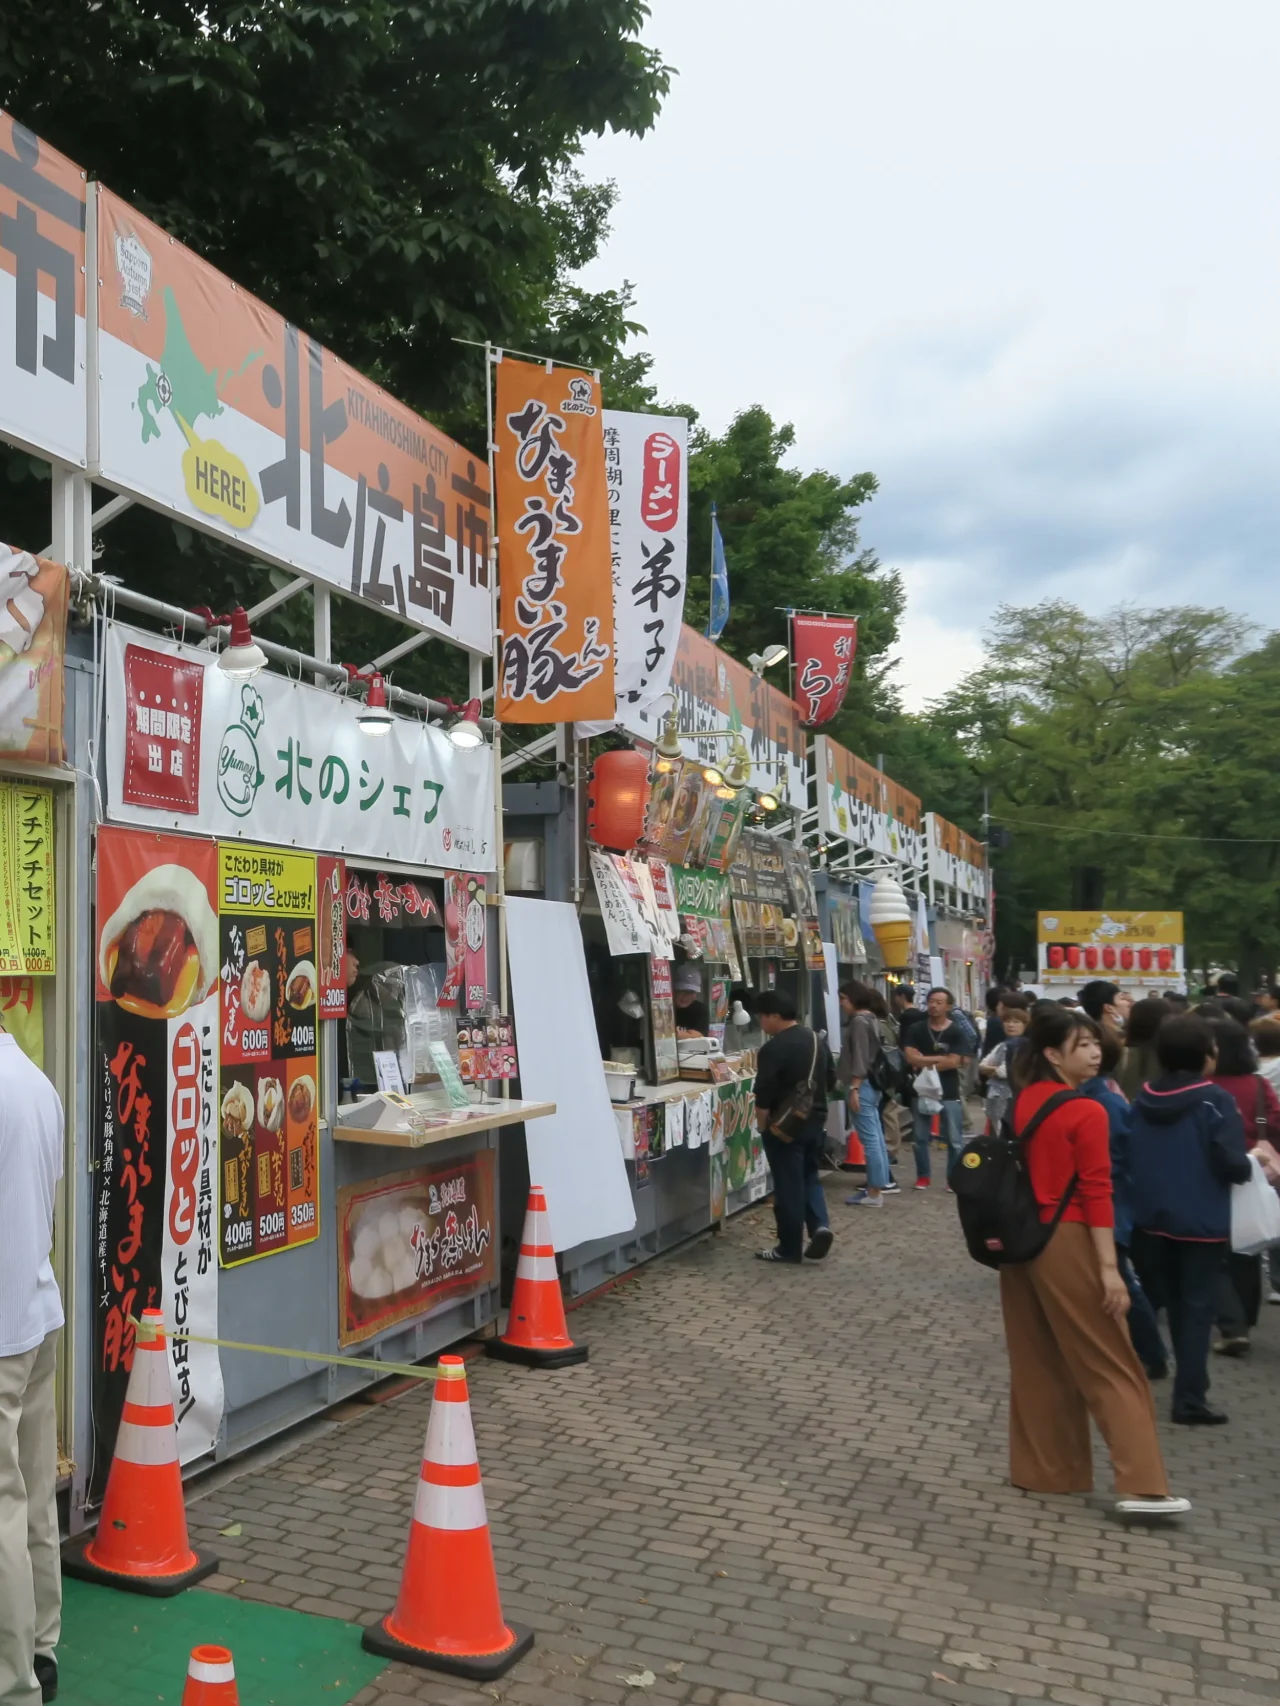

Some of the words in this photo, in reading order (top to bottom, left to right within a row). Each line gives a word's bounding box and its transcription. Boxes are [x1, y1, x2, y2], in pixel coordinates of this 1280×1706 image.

[347, 386, 428, 466] KITAHIROSHIMA
[428, 446, 451, 479] CITY
[195, 456, 247, 515] HERE!
[257, 322, 492, 627] 北広島市
[645, 434, 675, 521] ラーメン
[620, 538, 681, 700] 弟子
[136, 704, 192, 744] 期間限定
[148, 744, 183, 778] 出店
[220, 745, 257, 789] Yummy
[275, 735, 445, 825] 北のシェフ
[22, 793, 43, 945] プチプチセット
[224, 855, 284, 878] こだわり具材が
[224, 877, 276, 907] ゴロッと
[242, 1030, 269, 1051] 600円
[291, 1026, 315, 1046] 400円
[174, 1031, 196, 1233] ゴロッと
[197, 1025, 213, 1275] こだわり具材が
[225, 1221, 253, 1246] 400円
[260, 1212, 285, 1237] 500円
[291, 1202, 315, 1226] 350円
